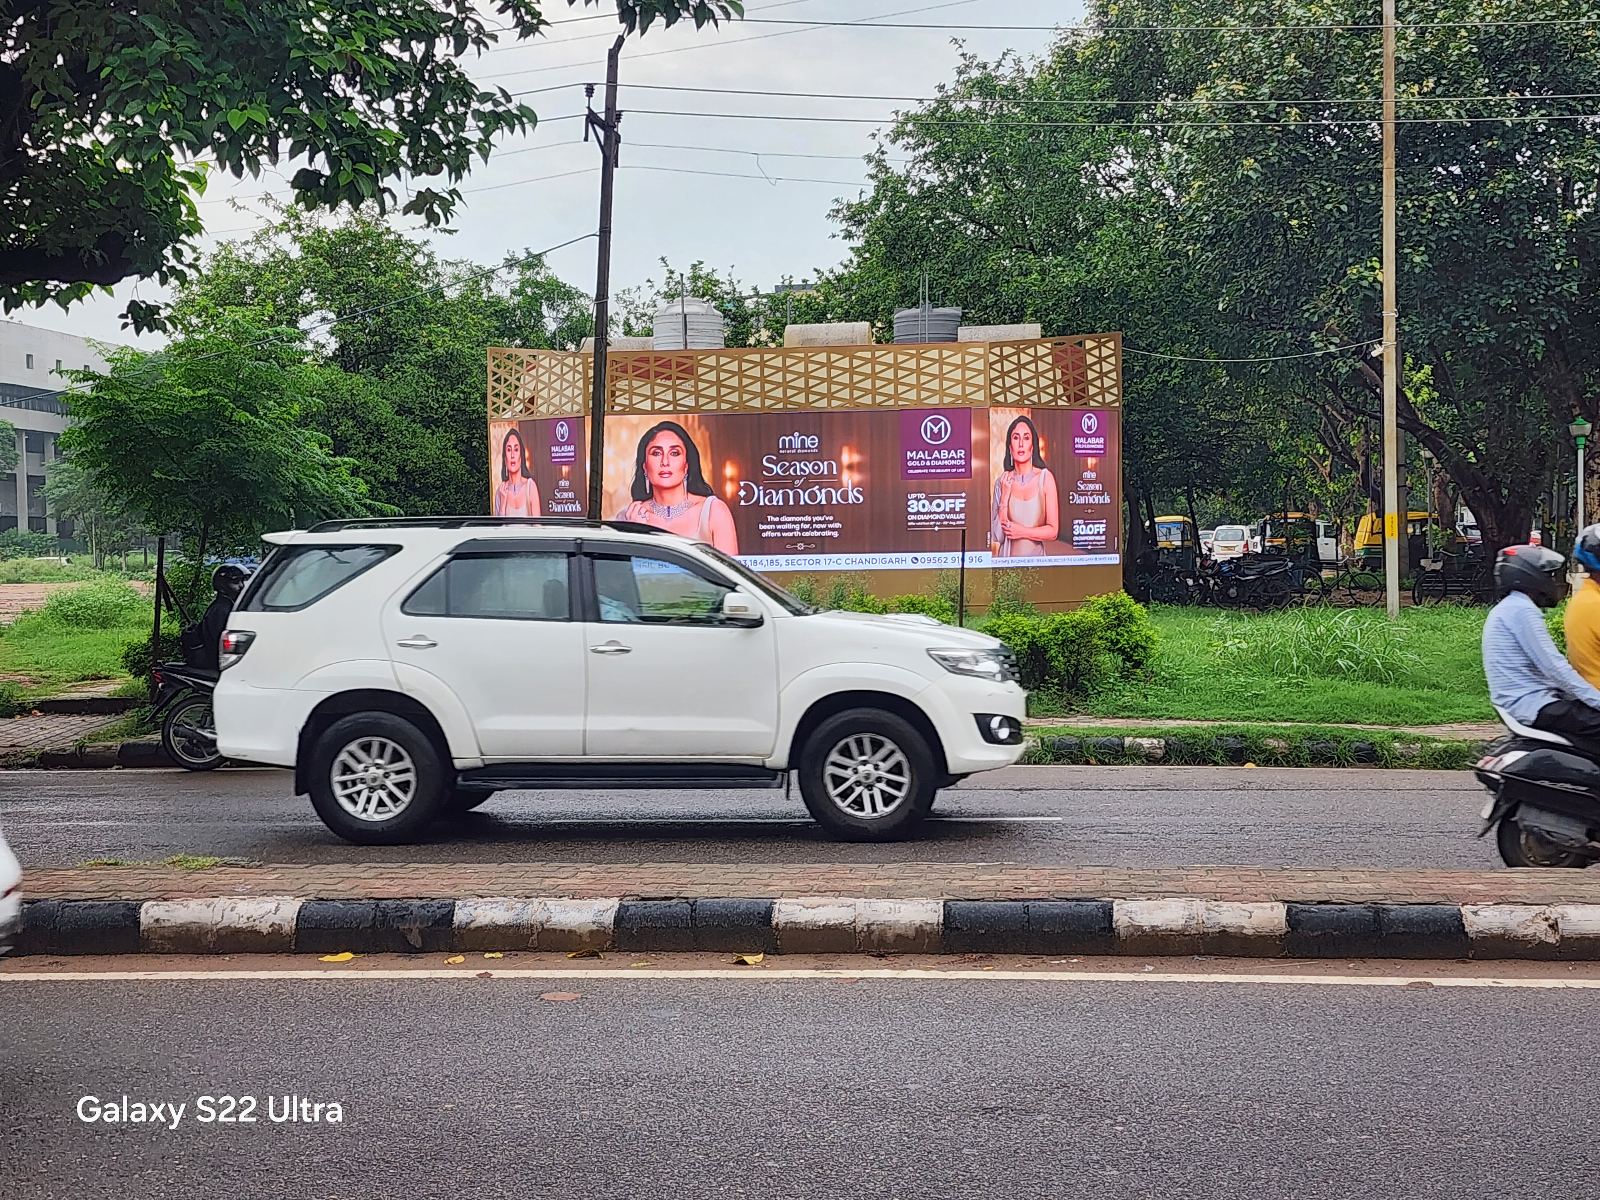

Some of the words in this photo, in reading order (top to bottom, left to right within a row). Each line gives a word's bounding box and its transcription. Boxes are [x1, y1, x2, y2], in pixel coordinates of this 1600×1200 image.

[779, 431, 819, 449] mine
[906, 449, 966, 461] MALABAR
[762, 455, 838, 477] Season
[794, 477, 806, 488] of
[1077, 480, 1103, 491] Season
[738, 479, 864, 506] Diamonds
[1069, 491, 1111, 504] Diamonds
[739, 559, 783, 568] 3,184,185,
[784, 558, 821, 567] SECTOR
[824, 557, 842, 565] 17-C
[844, 556, 907, 565] CHANDIGARH
[919, 556, 949, 564] 09562
[950, 556, 964, 564] 91
[968, 556, 983, 564] 916
